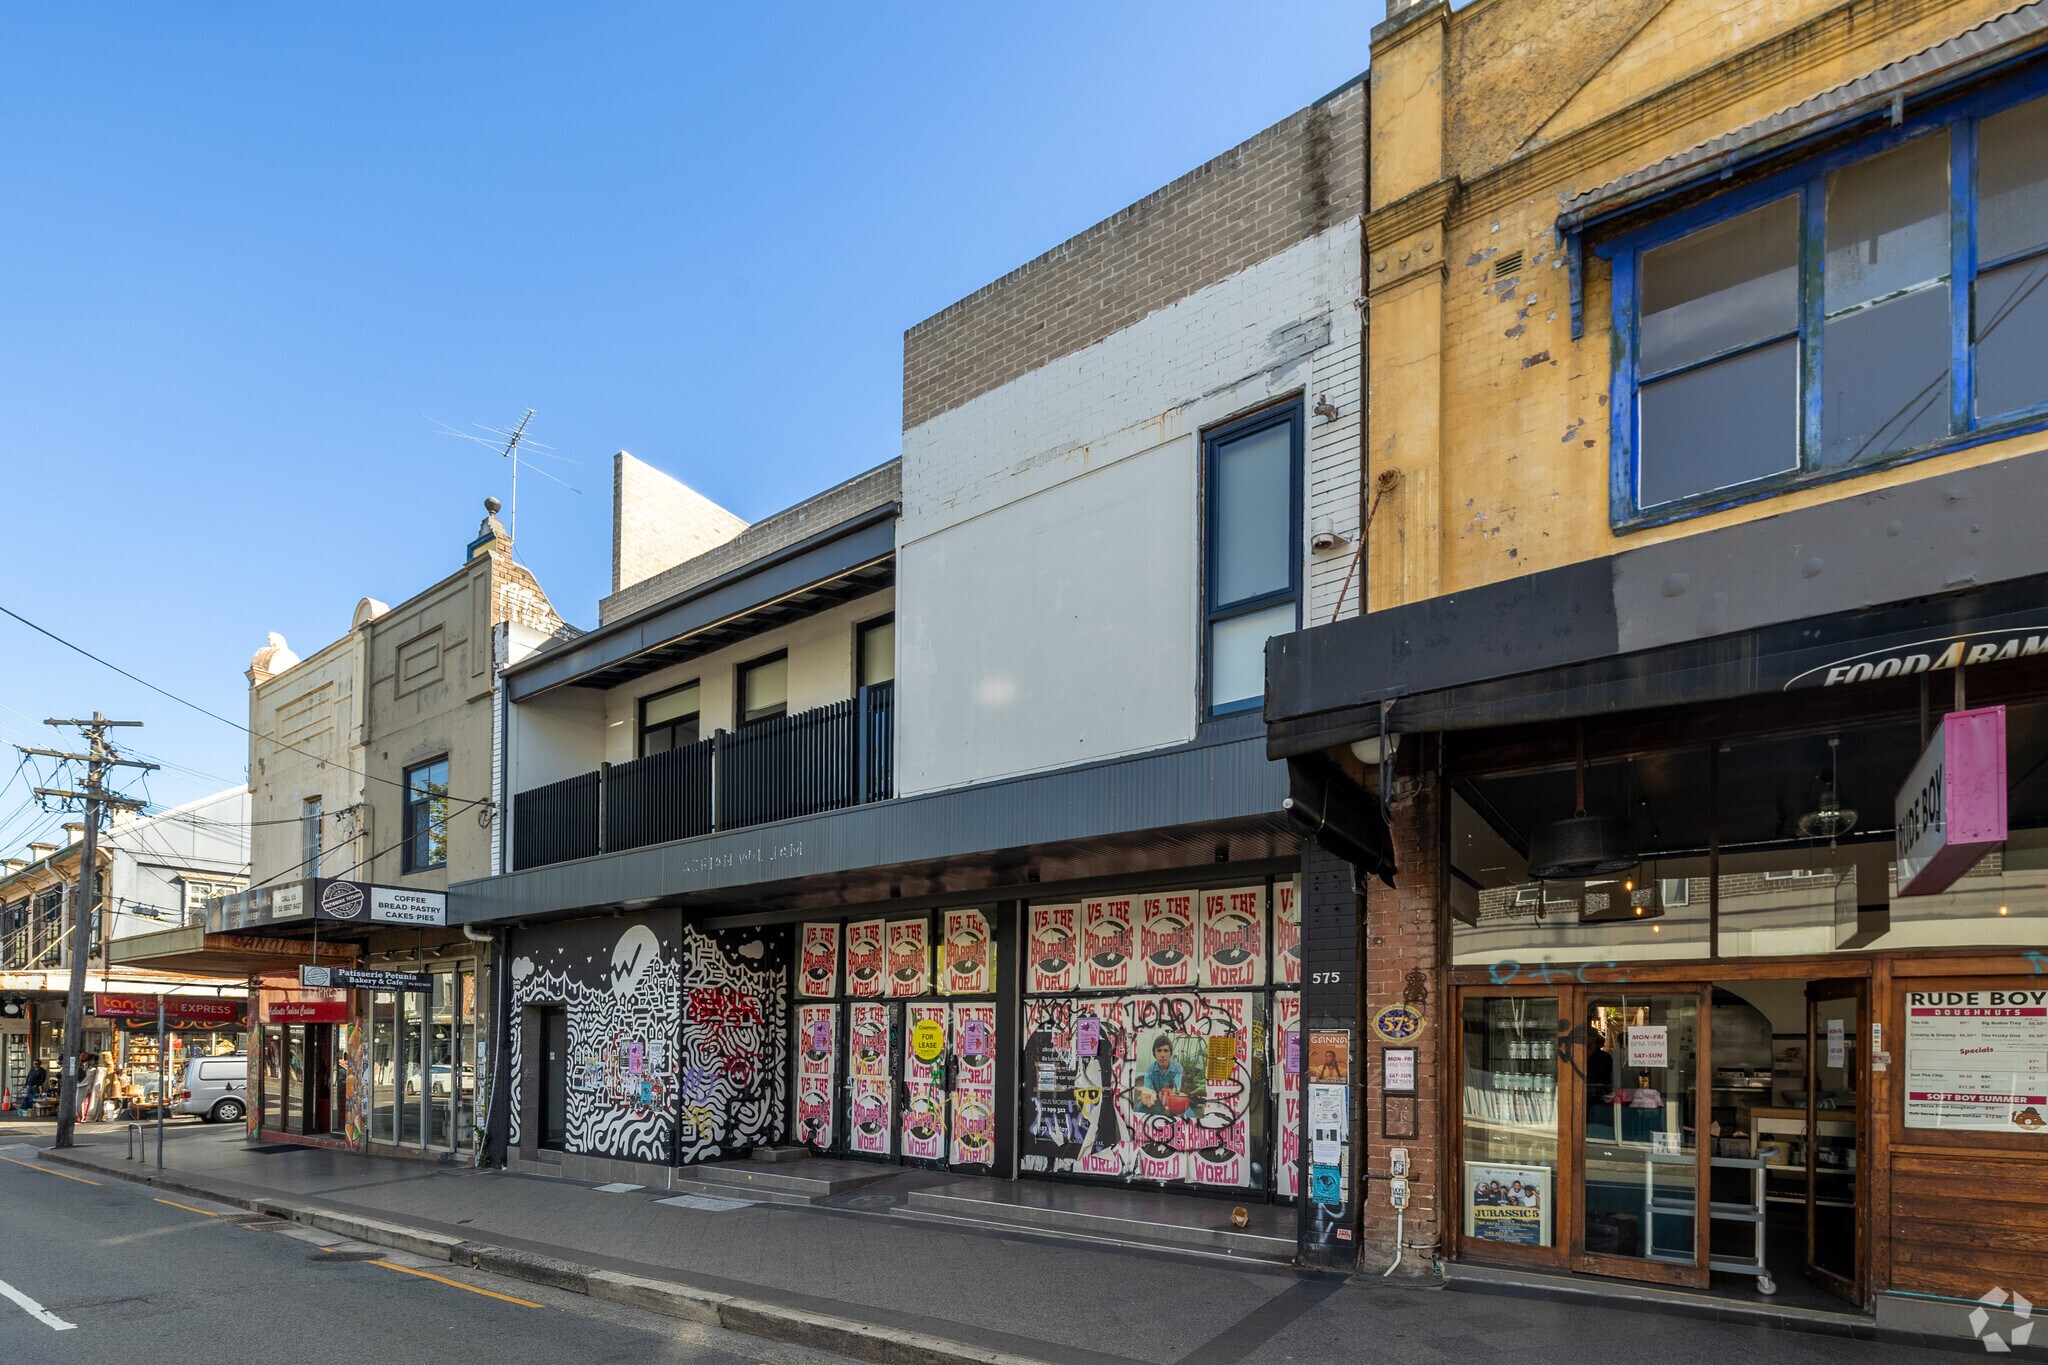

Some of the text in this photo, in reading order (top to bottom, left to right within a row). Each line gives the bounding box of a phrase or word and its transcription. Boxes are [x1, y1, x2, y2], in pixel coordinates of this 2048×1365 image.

[1922, 763, 1942, 833] BOY
[378, 902, 441, 914] BREAD PASTRY
[394, 895, 426, 904] COFFEE
[1144, 896, 1190, 923] VS. THE
[1206, 892, 1256, 921] VS. THE
[385, 912, 414, 920] CAKES
[1035, 909, 1074, 935] VS. THE
[1087, 901, 1130, 926] VS. THE
[820, 927, 834, 947] THE
[864, 924, 880, 945] THE
[905, 924, 922, 945] THE
[338, 969, 417, 981] Patisserie Petunia
[349, 977, 377, 985] Bakery
[386, 978, 403, 986] Cafe
[950, 968, 982, 991] WORLD
[1035, 966, 1070, 991] WORLD
[1088, 961, 1127, 987] WORLD
[1145, 959, 1188, 986] WORLD
[1208, 958, 1254, 986] WORLD
[1312, 971, 1340, 984] 575
[805, 974, 830, 996] WORLD
[852, 975, 879, 996] WORLD
[892, 976, 921, 997] WORLD
[181, 1003, 231, 1014] EXPRESS
[1911, 991, 2047, 1006] RUDE BOY
[869, 1007, 885, 1028] THE
[975, 1008, 994, 1030] THE
[1217, 999, 1243, 1025] THE
[1959, 1047, 1994, 1055] Specials
[803, 1055, 828, 1074] WORLD
[814, 1078, 829, 1098] THE
[1926, 1093, 2028, 1104] SOFT BOY SUMMER
[857, 1128, 884, 1151] WORLD
[907, 1133, 937, 1157] WORLD
[1193, 1154, 1239, 1184] WORLD
[1475, 1209, 1540, 1218] JURASSIC 5
